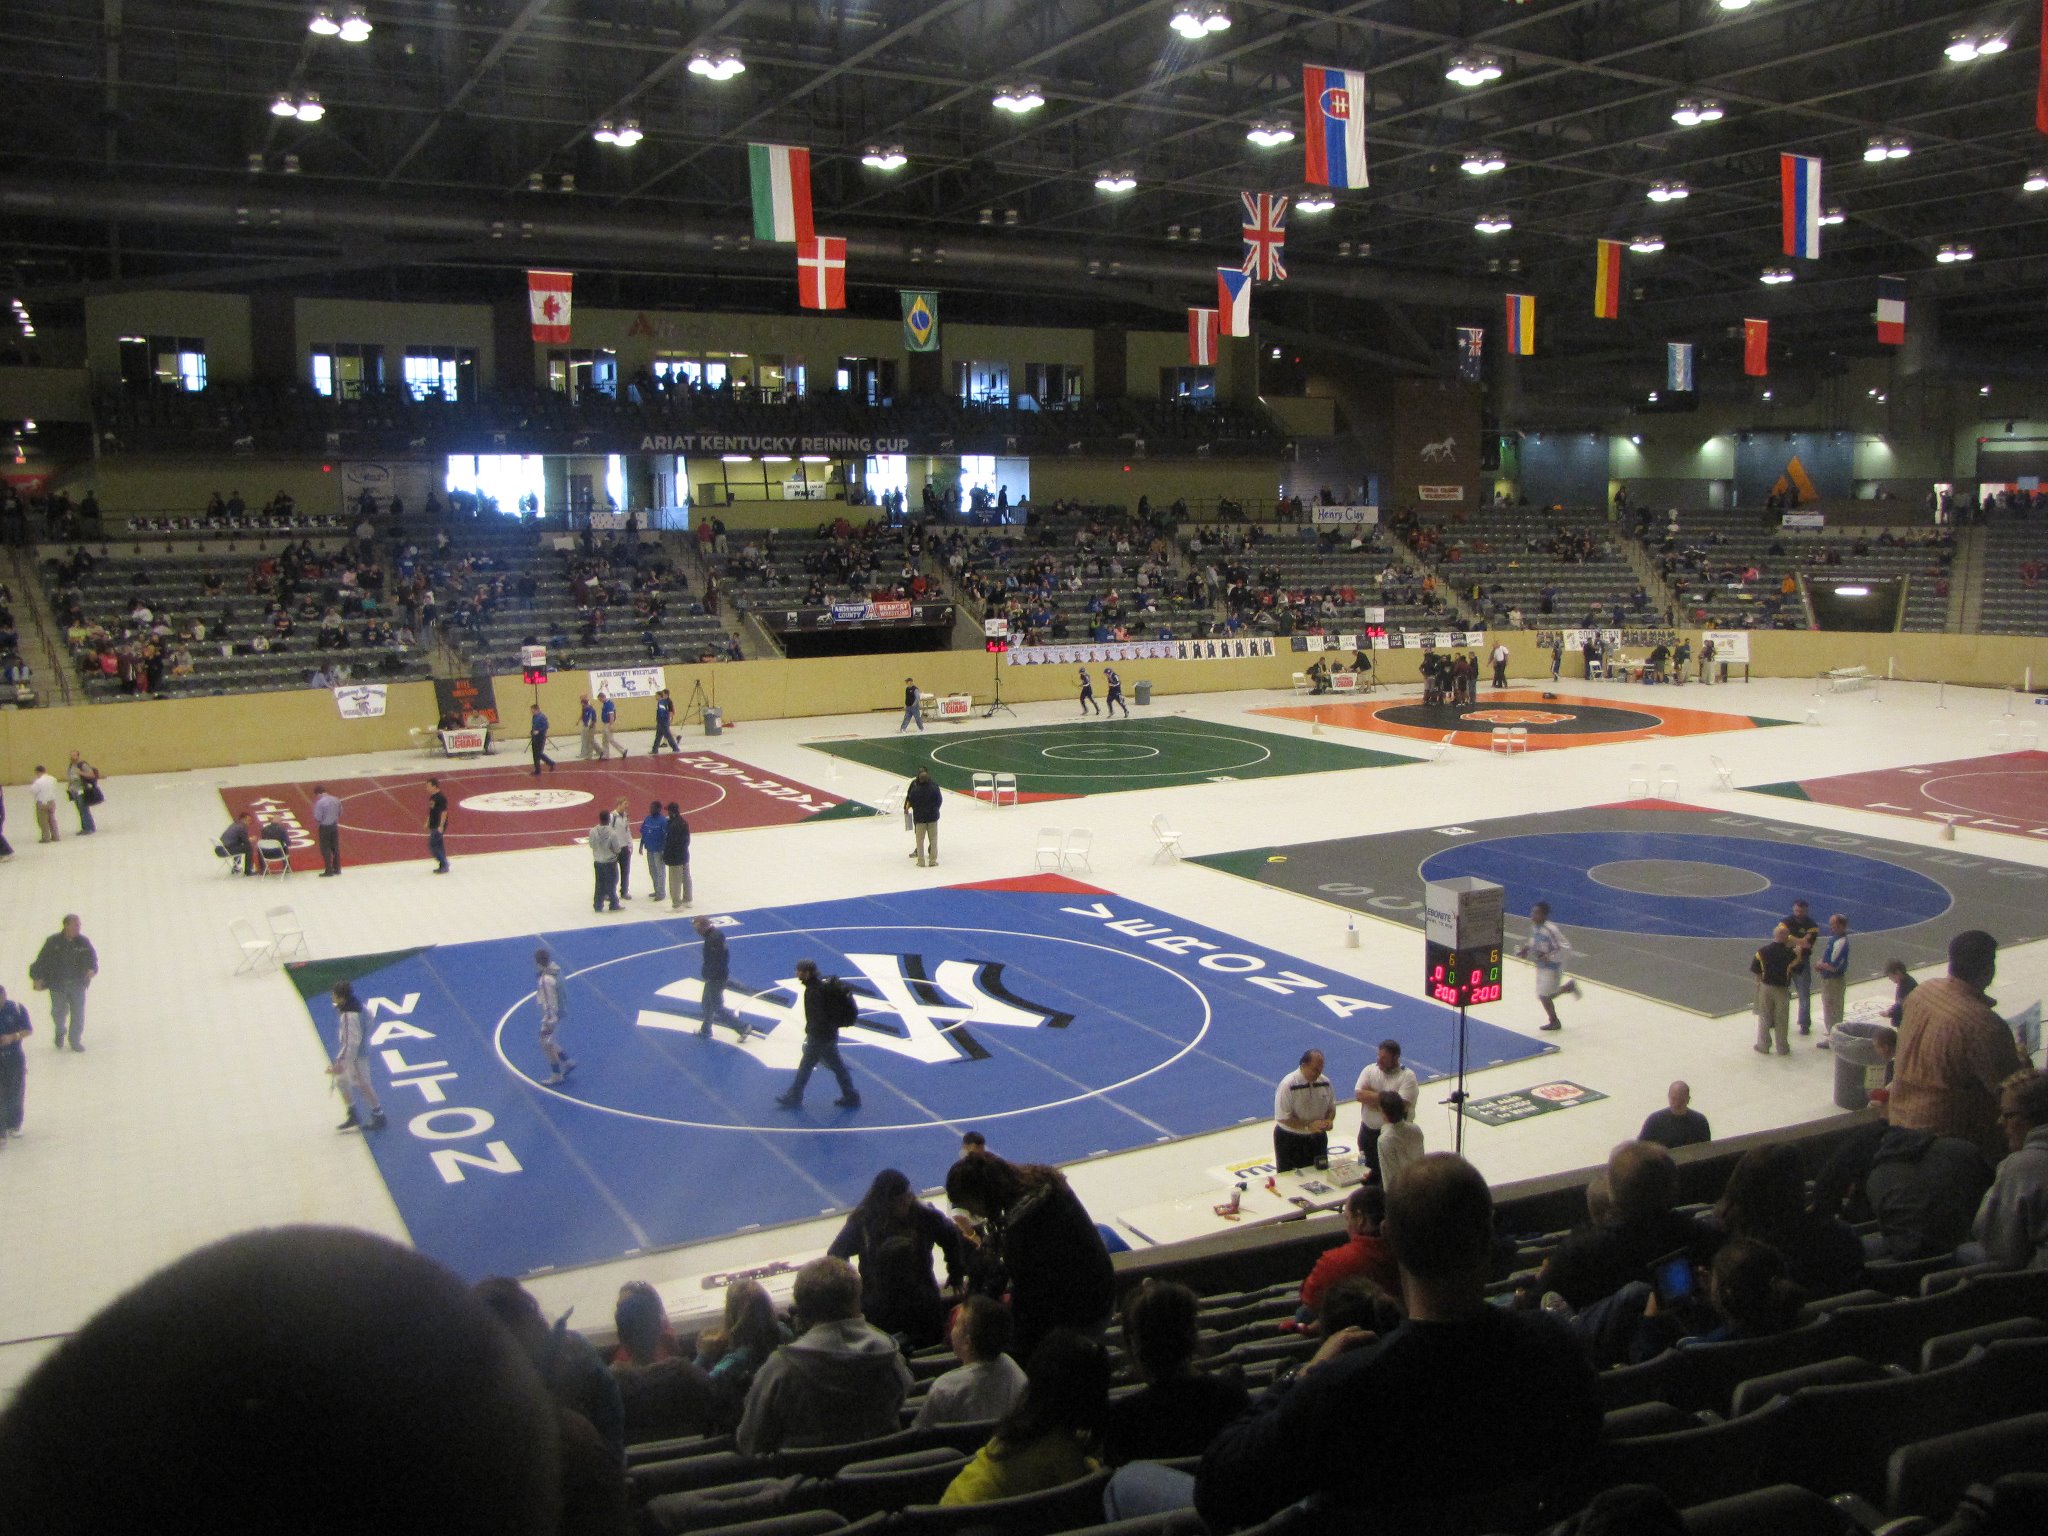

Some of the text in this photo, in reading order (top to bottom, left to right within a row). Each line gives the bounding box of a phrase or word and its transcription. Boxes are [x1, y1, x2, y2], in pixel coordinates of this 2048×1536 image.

[640, 436, 909, 451] ARIAT KENTUCKY REINING CUP
[1318, 508, 1365, 521] Henry Clay
[945, 704, 967, 714] GUARD
[454, 738, 482, 748] GUARD
[1427, 907, 1451, 922] EBONITE
[1060, 903, 1392, 1018] VERONA
[1449, 953, 1455, 966] 6
[1435, 966, 1443, 980] 0
[1449, 971, 1455, 984] 0
[1470, 969, 1482, 985] 0
[1490, 967, 1498, 980] 0
